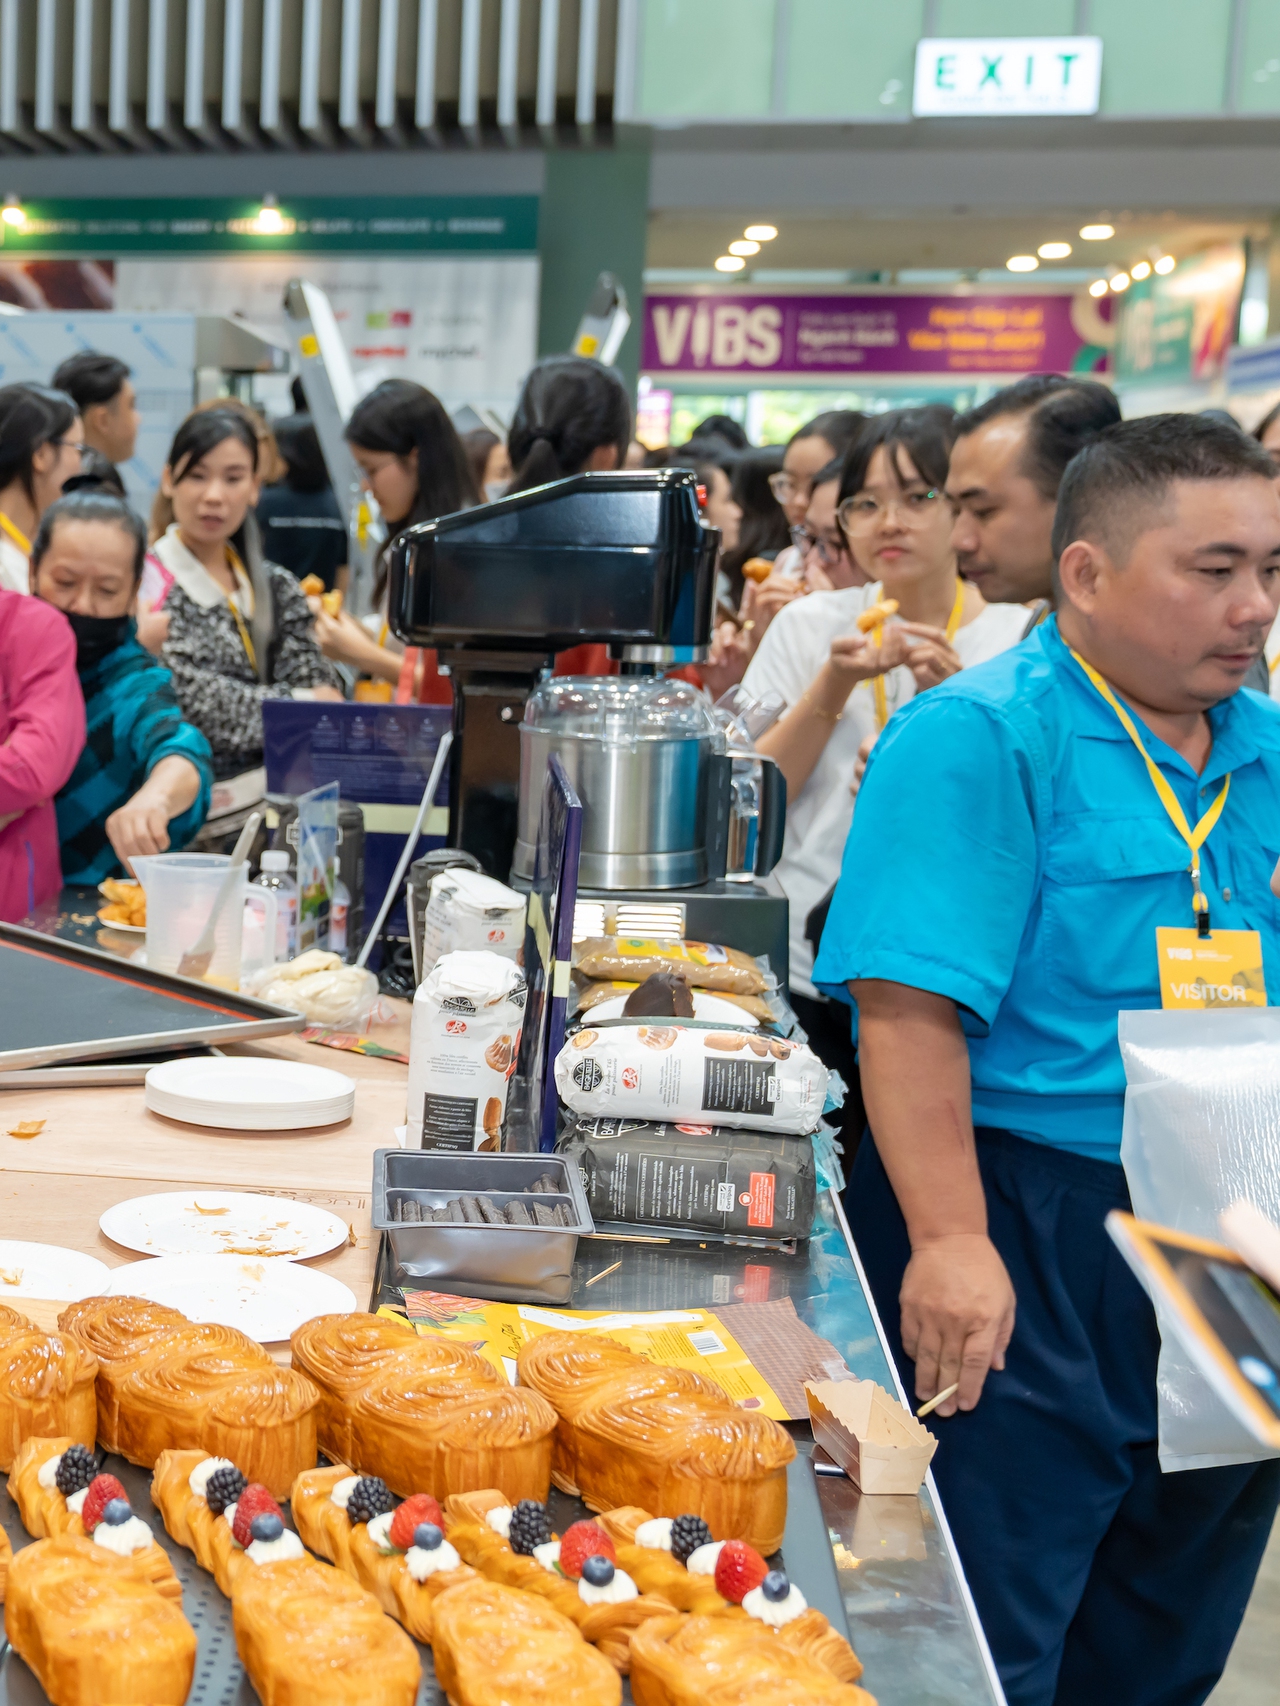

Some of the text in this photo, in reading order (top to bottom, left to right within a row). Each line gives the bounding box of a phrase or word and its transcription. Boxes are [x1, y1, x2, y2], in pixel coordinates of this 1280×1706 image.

[935, 54, 1079, 90] EXIT
[1170, 983, 1247, 1002] VISITOR
[583, 1059, 592, 1091] BAGATELLE
[725, 1185, 733, 1210] Certipaq
